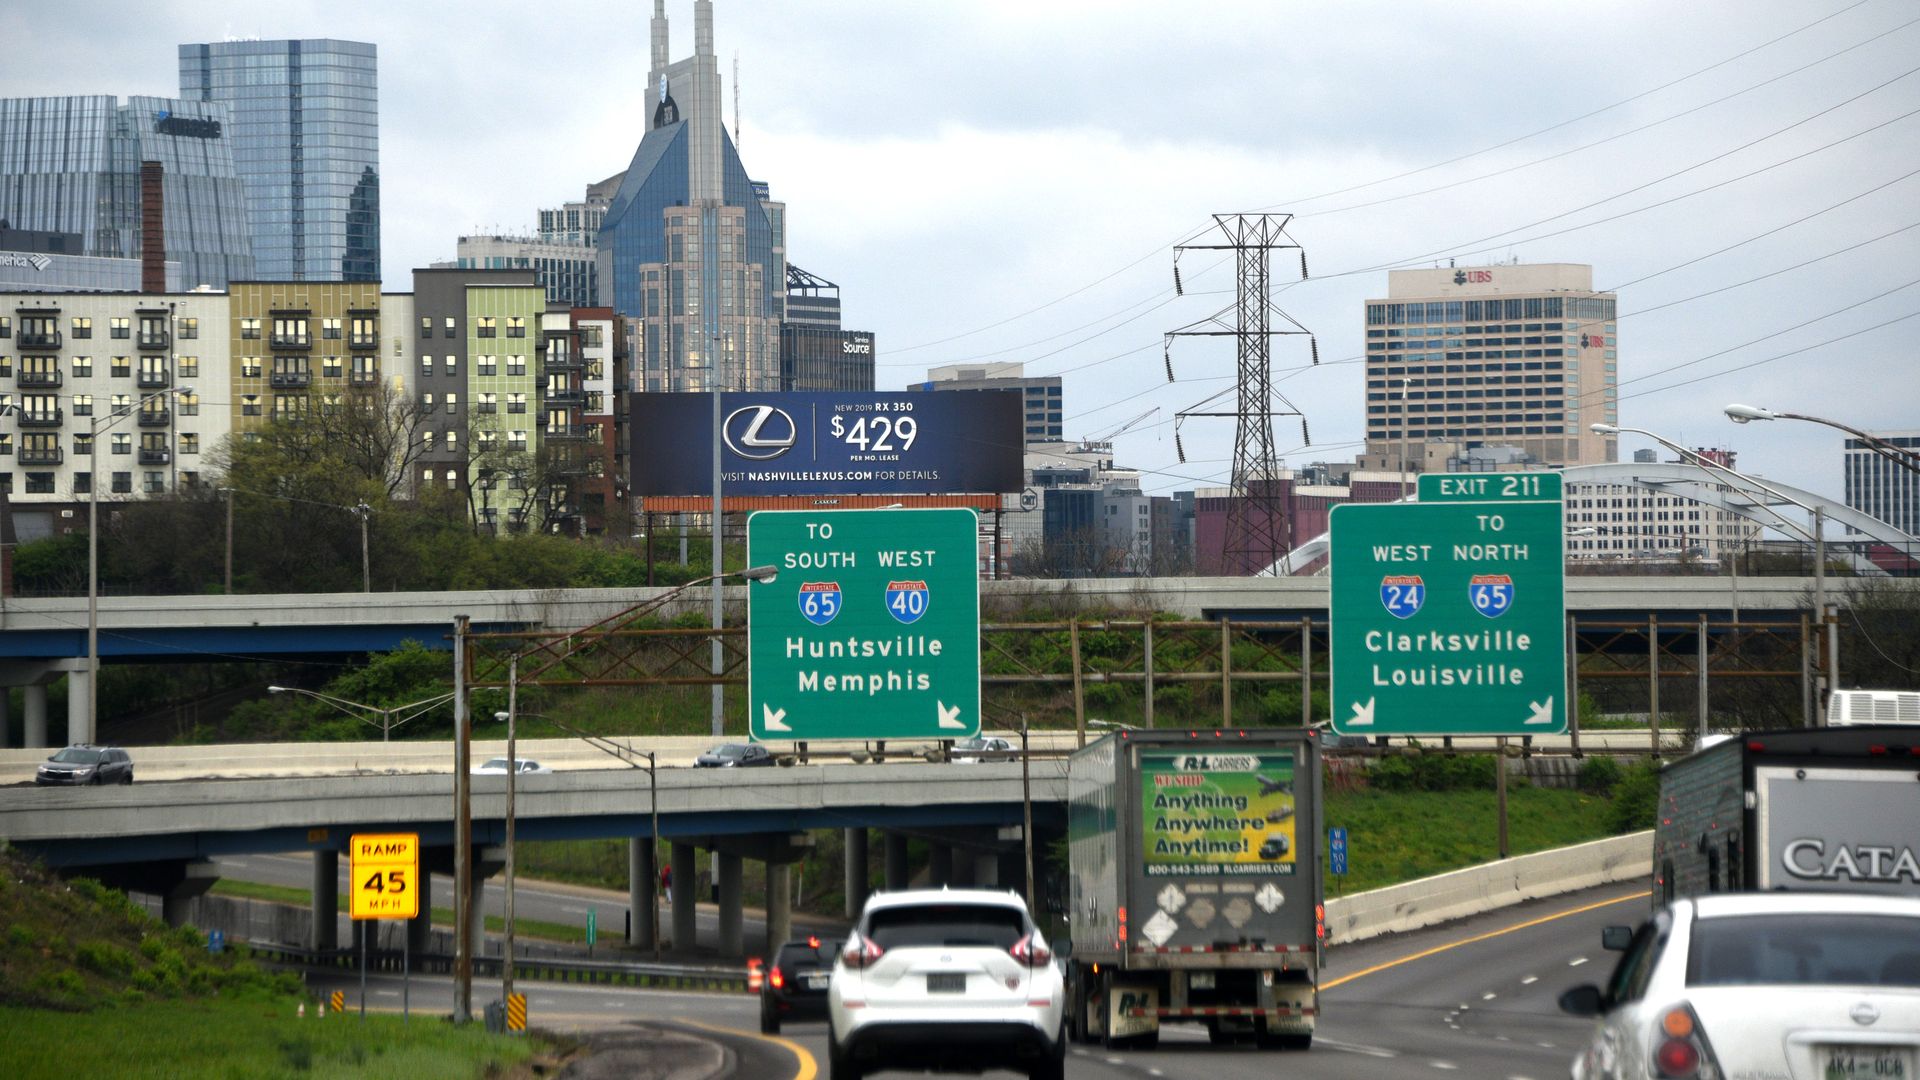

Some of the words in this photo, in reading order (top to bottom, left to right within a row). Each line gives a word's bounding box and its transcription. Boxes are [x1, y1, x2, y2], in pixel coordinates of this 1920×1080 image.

[1468, 271, 1492, 283] UBS
[843, 341, 870, 354] Source
[1590, 335, 1604, 348] UBS
[835, 404, 853, 412] NEW
[855, 404, 873, 412] 2019
[875, 402, 889, 411] RX
[893, 402, 913, 411] 350
[831, 414, 917, 451] $429
[721, 472, 745, 482] VISIT
[749, 471, 872, 481] NASHVILLELEXUS.COM
[876, 471, 895, 480] FOR
[898, 470, 941, 480] DETAILS.
[1440, 479, 1488, 495] EXIT
[1501, 477, 1539, 496] 211
[806, 523, 833, 539] TO
[1476, 515, 1504, 531] TO
[784, 552, 856, 568] SOUTH
[878, 551, 936, 567] WEST
[1373, 545, 1431, 561] WEST
[1453, 544, 1529, 561] NORTH
[805, 592, 835, 616] 65
[892, 591, 922, 614] 40
[1387, 586, 1418, 610] 24
[1476, 586, 1506, 609] 65
[786, 636, 942, 658] Huntsville
[1365, 630, 1531, 652] Clarksville
[799, 669, 930, 696] Memphis
[1373, 664, 1524, 686] Louisville
[1212, 756, 1250, 770] CARRIERS
[1154, 775, 1171, 787] WE
[1175, 774, 1204, 787] SHIP
[1154, 793, 1248, 811] Anything
[1155, 816, 1265, 834] Anywhere
[362, 844, 407, 856] RAMP
[1155, 838, 1249, 856] Anytime!
[1782, 838, 1920, 884] CATA
[363, 871, 406, 894] 45
[369, 899, 401, 910] MPH
